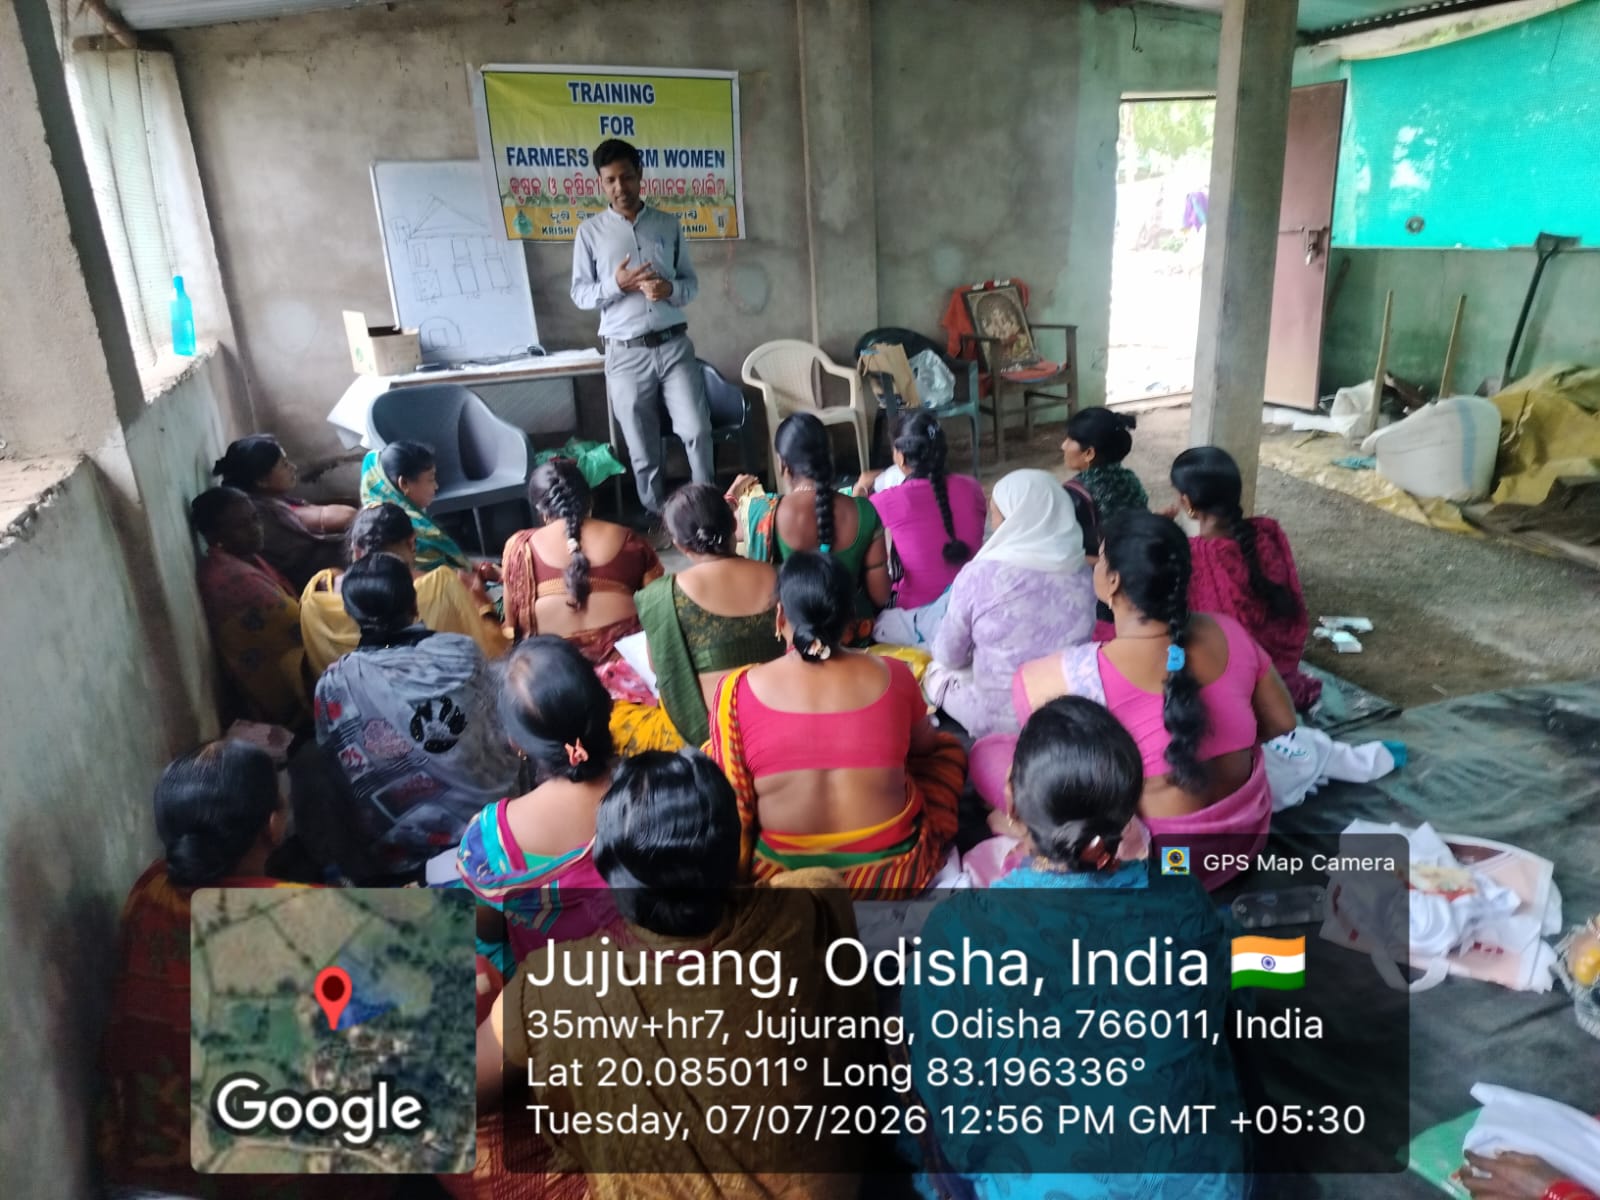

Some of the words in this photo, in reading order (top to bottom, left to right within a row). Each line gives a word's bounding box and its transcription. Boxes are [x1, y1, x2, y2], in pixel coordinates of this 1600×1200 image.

[568, 82, 655, 105] TRAINING
[600, 116, 635, 136] FOR
[506, 147, 589, 167] FARMERS
[636, 149, 659, 168] RM
[664, 149, 725, 168] WOMEN
